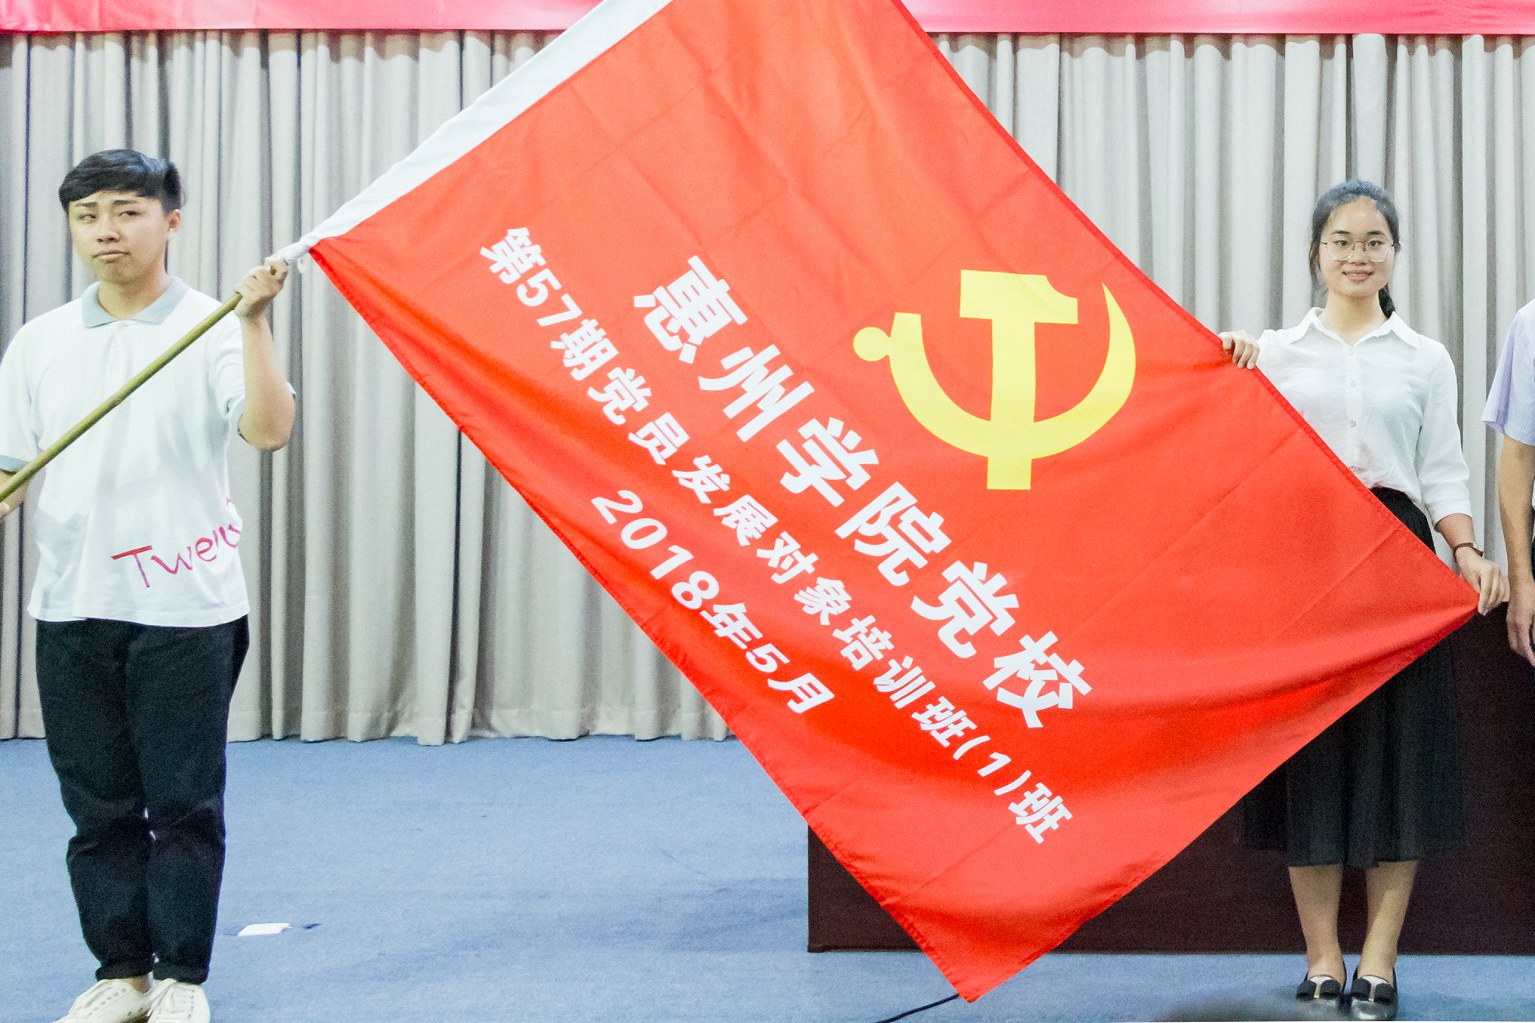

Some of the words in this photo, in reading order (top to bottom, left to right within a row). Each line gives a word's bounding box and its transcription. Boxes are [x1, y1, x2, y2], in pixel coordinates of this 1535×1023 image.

[479, 226, 1073, 845] 第57期党员发展对象培训班(1)班
[591, 489, 835, 714] 2018年5月
[633, 254, 1093, 729] 惠州学院党校
